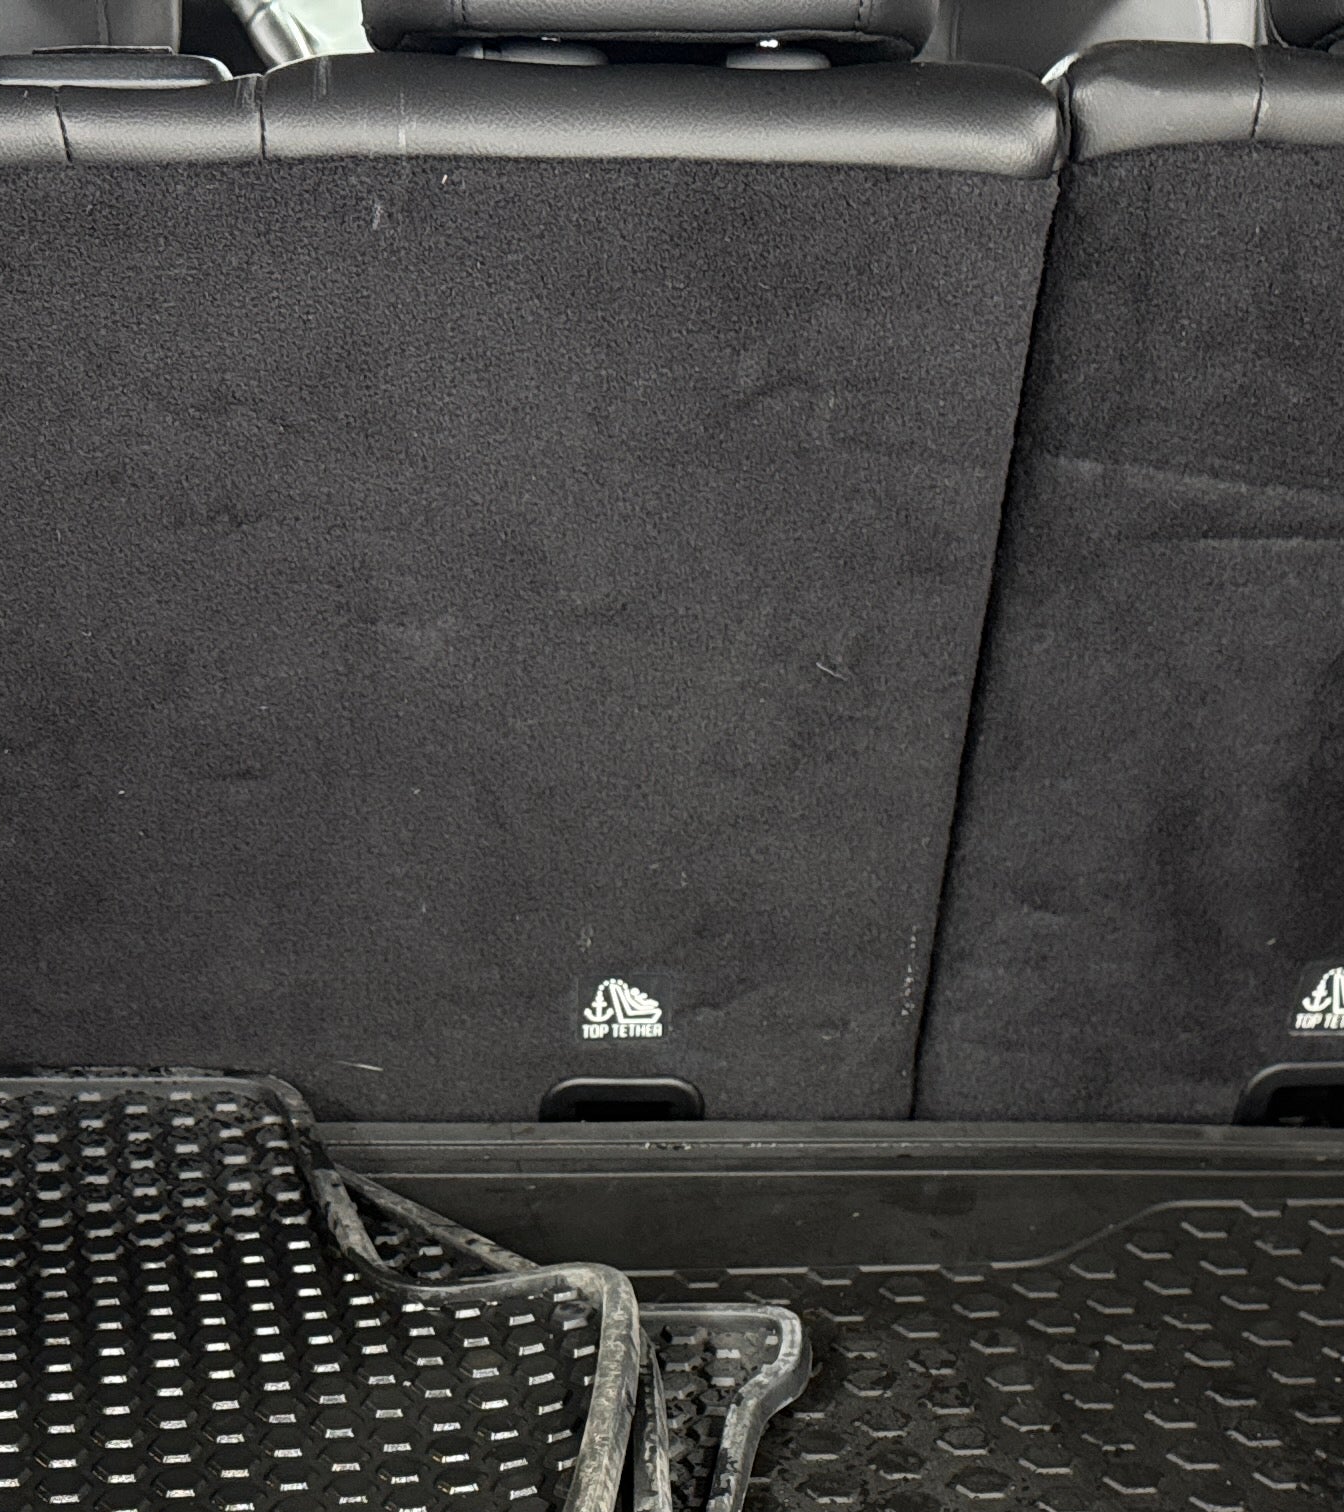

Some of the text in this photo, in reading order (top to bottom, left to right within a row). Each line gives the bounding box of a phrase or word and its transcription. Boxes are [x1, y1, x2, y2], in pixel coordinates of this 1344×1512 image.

[1295, 1012, 1324, 1029] TOP
[582, 1023, 663, 1039] TOP TETHER
